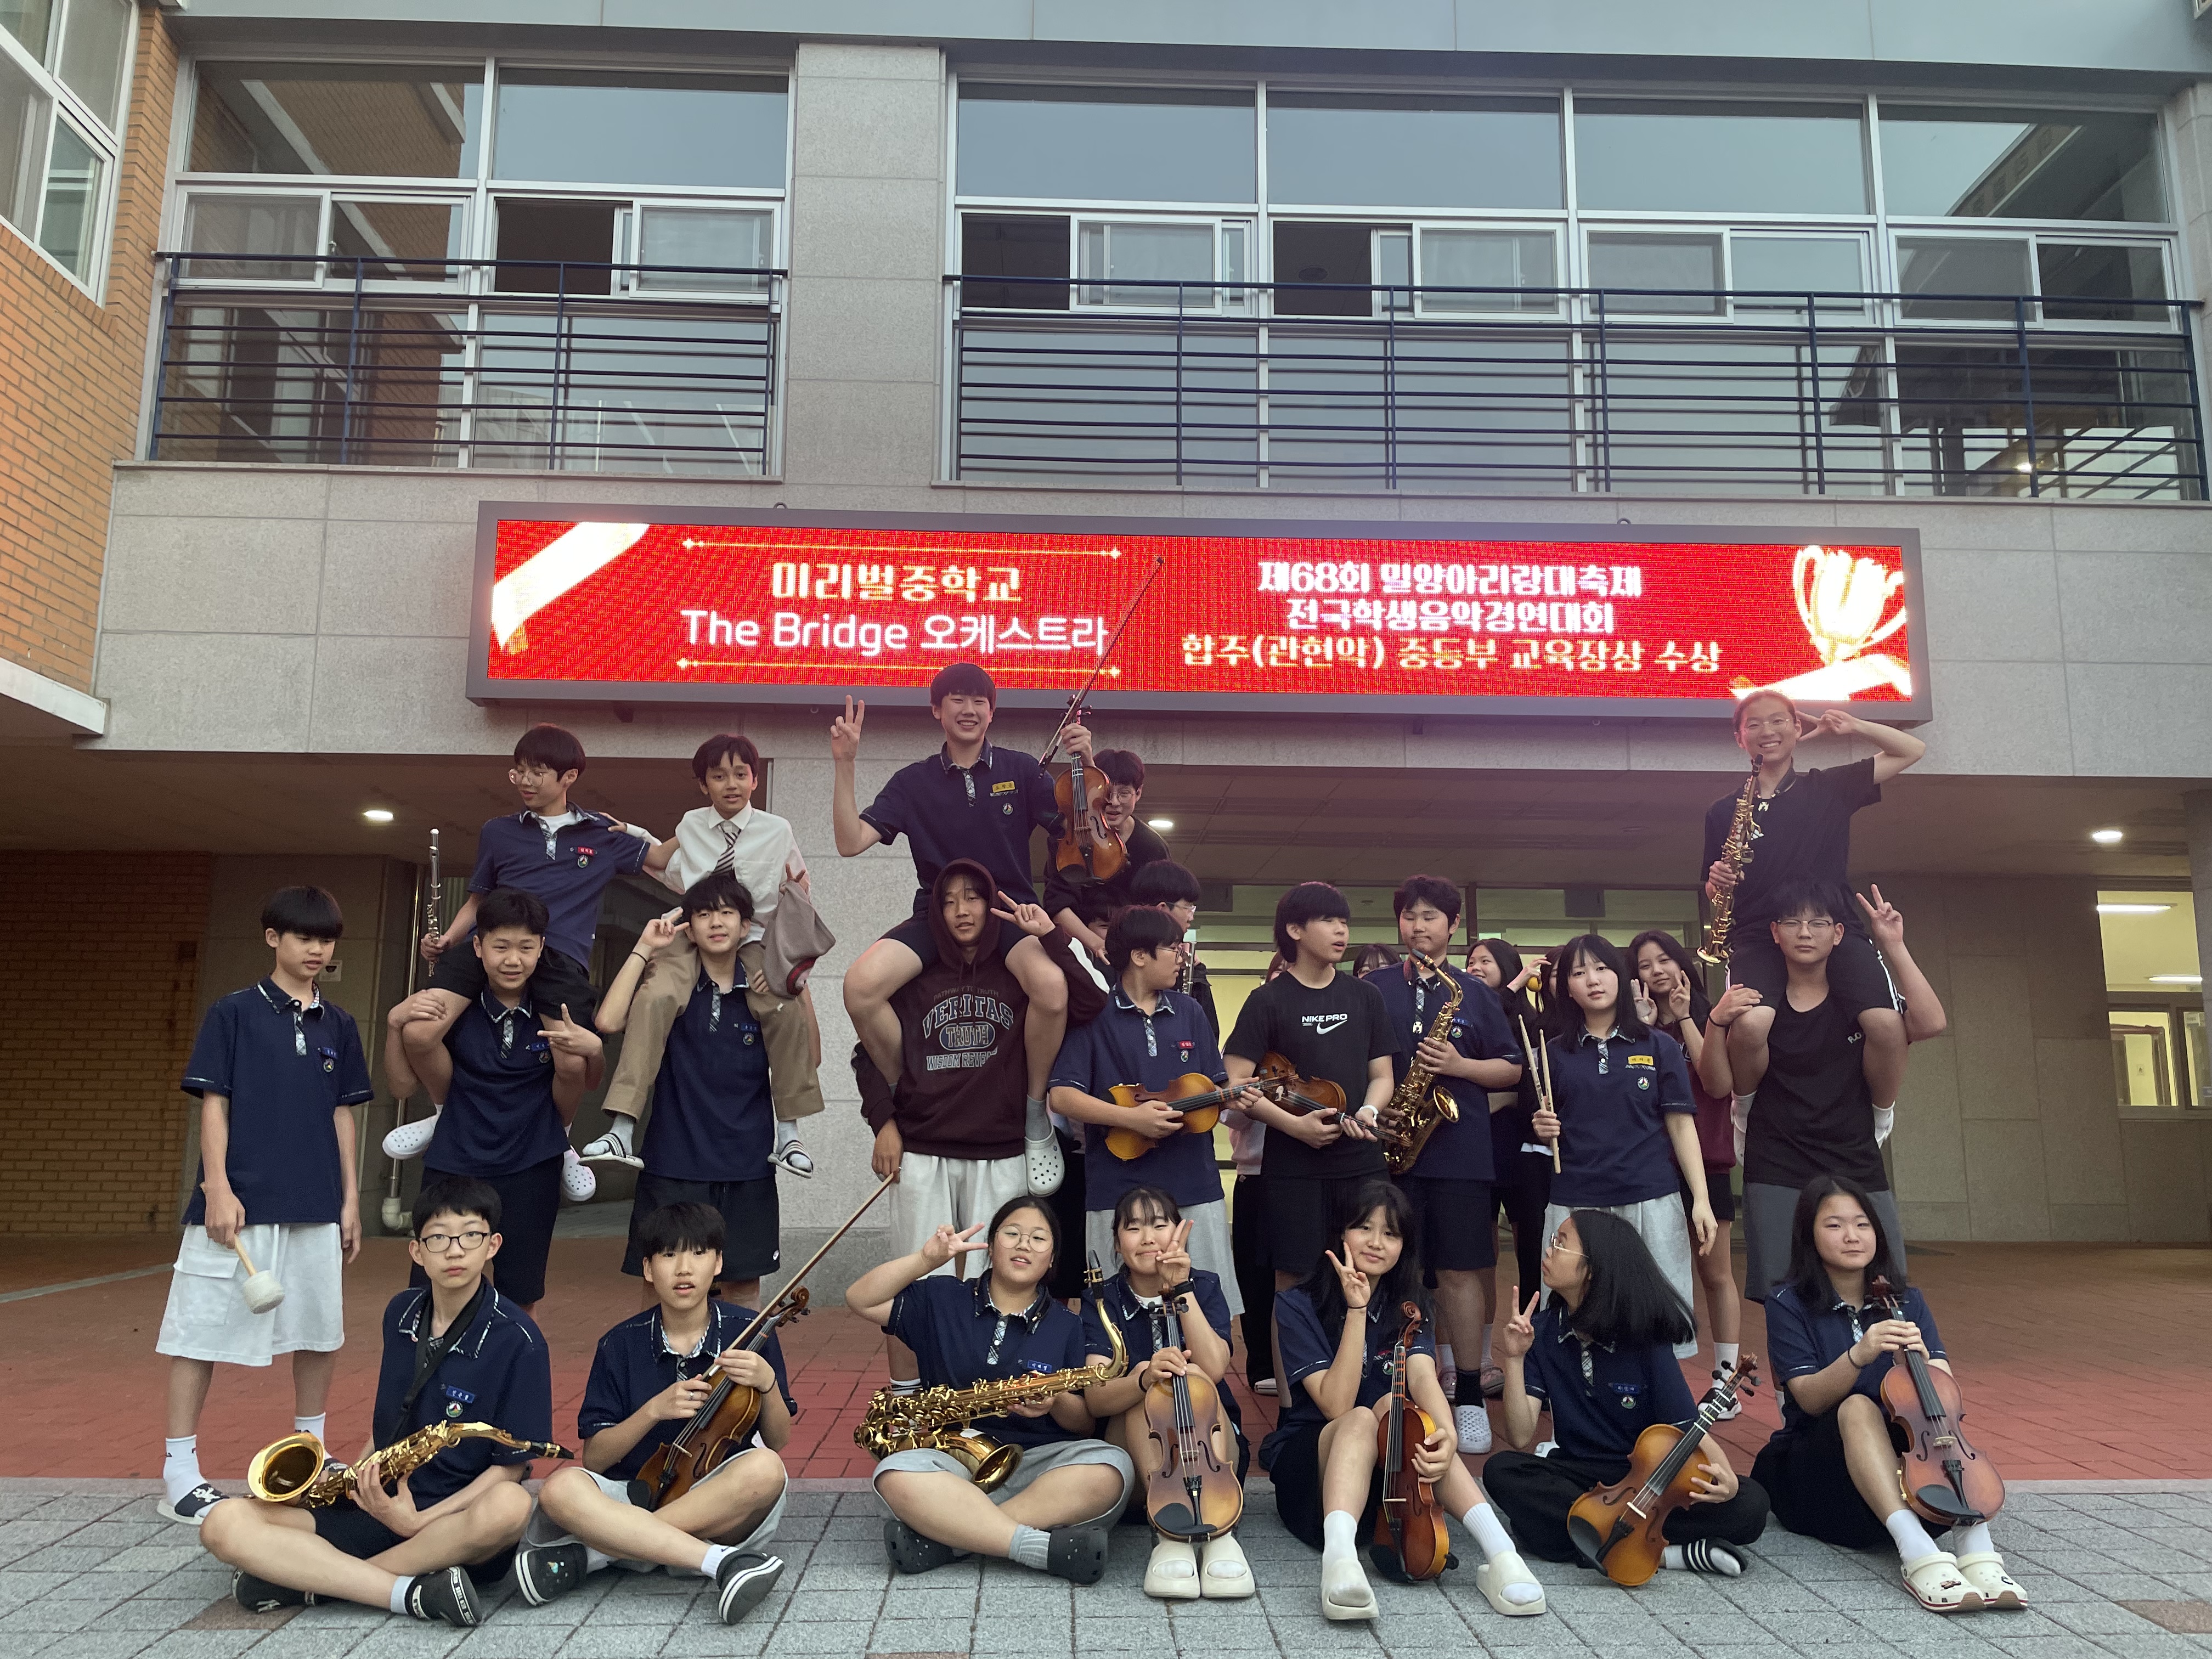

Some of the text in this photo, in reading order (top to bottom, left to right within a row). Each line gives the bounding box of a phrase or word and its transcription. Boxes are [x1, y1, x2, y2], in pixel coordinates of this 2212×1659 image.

[772, 562, 1021, 602] 미리벌중학교
[1257, 561, 1642, 597] 제68회 밀양아리랑대축제
[680, 609, 1109, 656] The Bridge 오케스트라
[1286, 599, 1615, 634] 전국학생음악경연대회
[1182, 635, 1723, 673] 합주(관현악) 중등부 교육장상 수상
[923, 994, 1014, 1039] VERITAS
[1326, 1013, 1347, 1022] PRO
[946, 1025, 989, 1047] TRUTH
[927, 1053, 961, 1070] WISDOM
